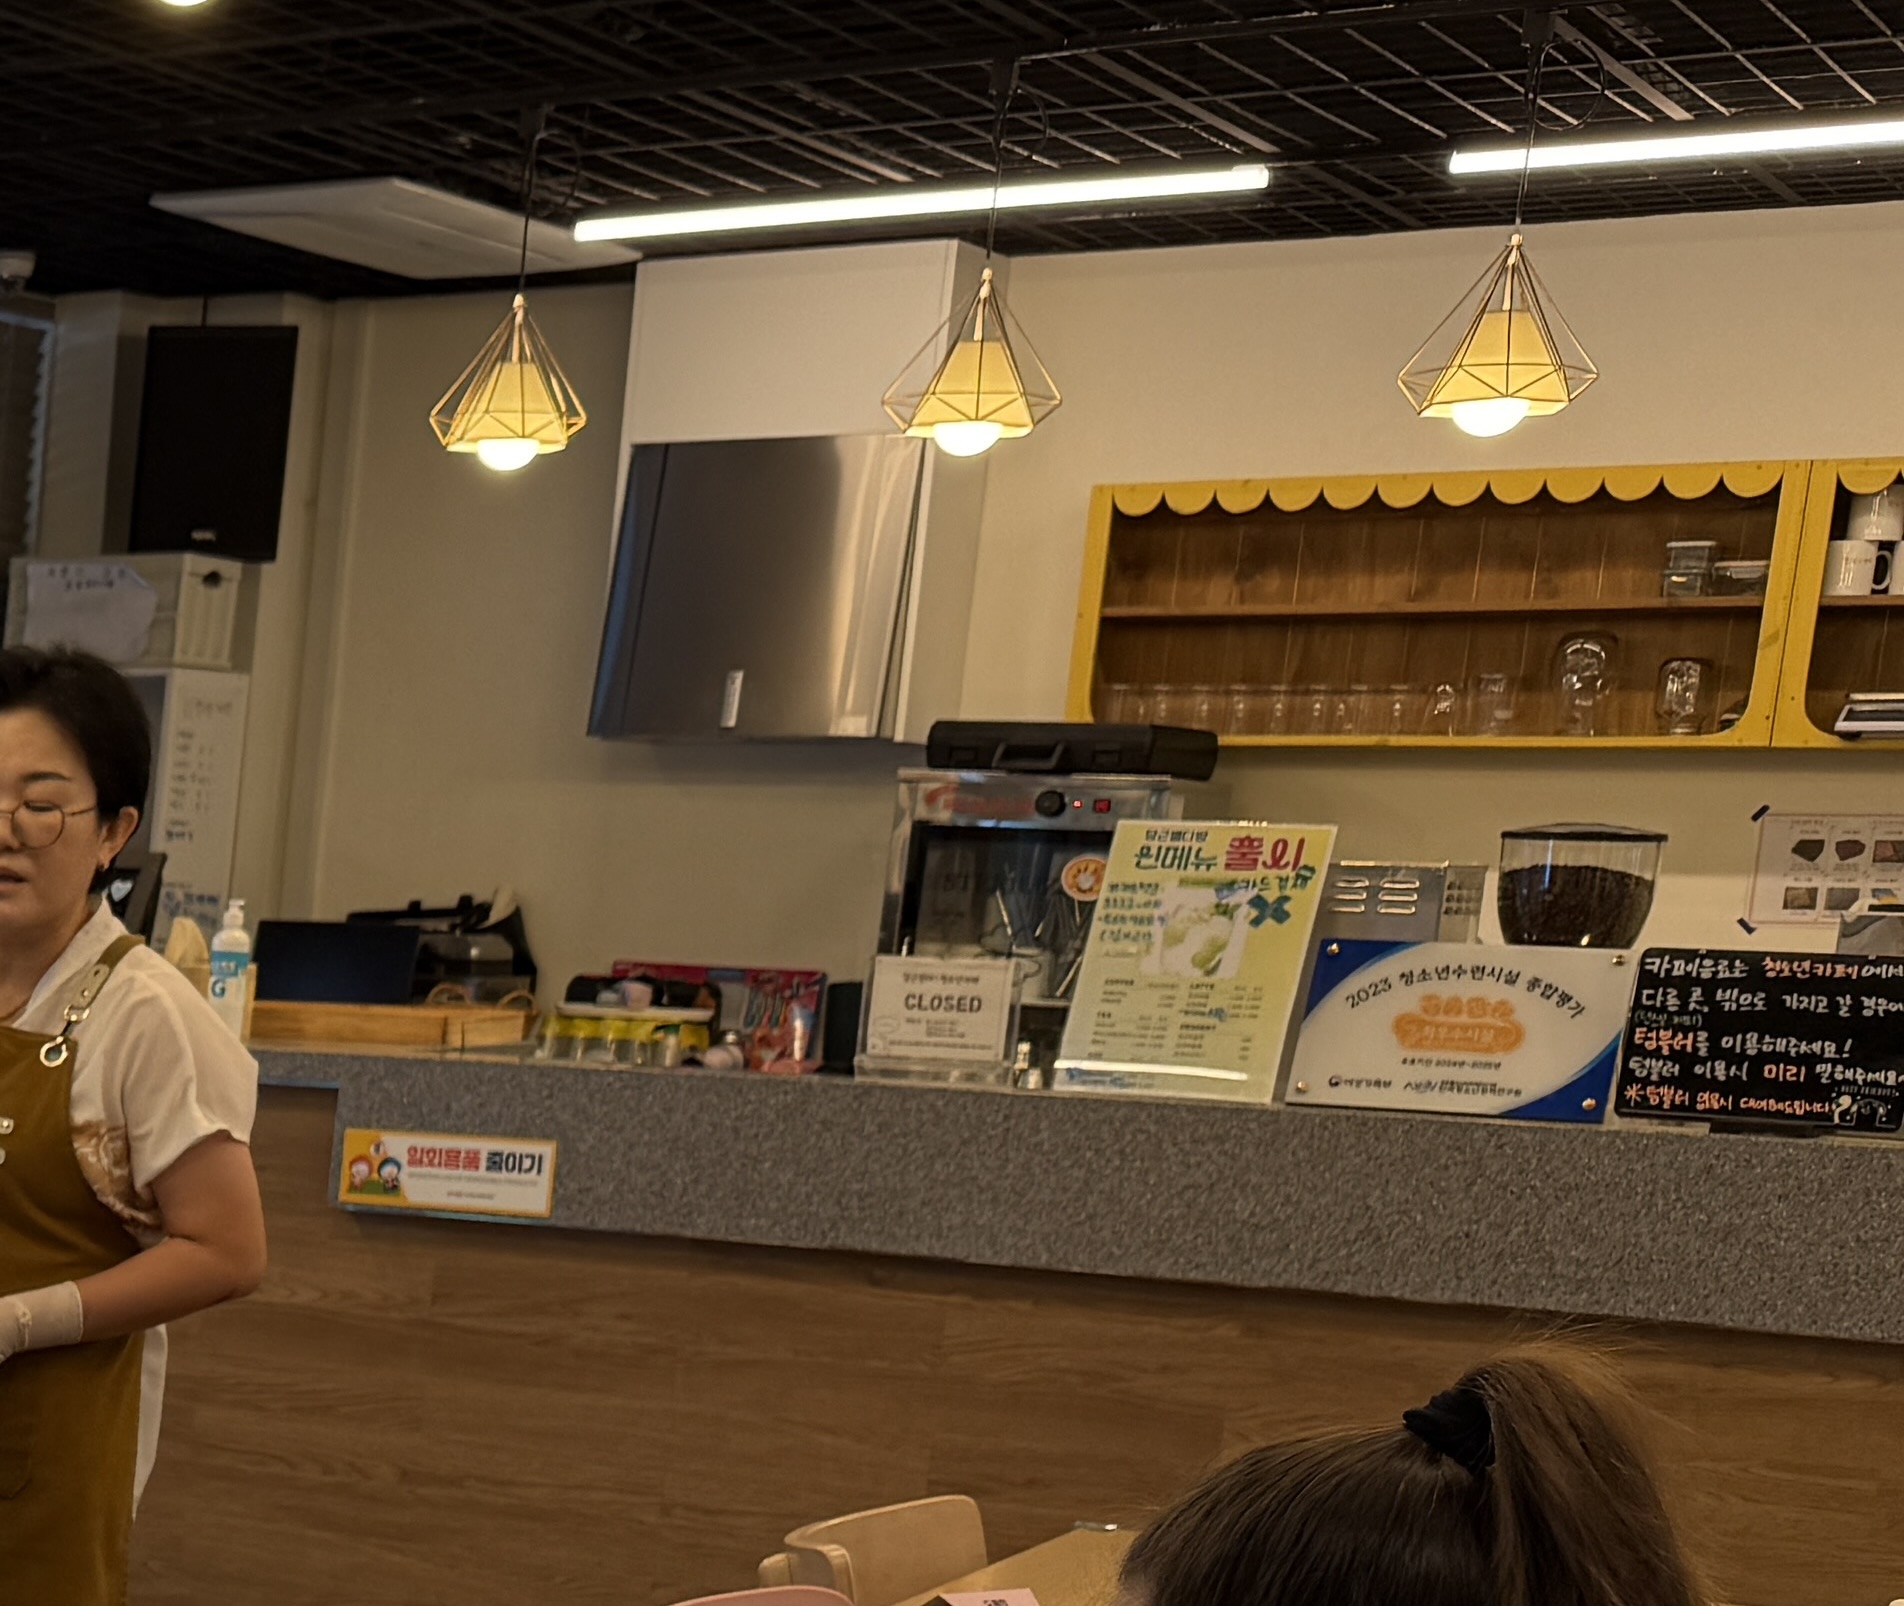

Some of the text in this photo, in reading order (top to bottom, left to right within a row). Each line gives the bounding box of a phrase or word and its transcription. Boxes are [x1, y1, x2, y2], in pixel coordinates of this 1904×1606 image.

[1644, 956, 1750, 979] 카페음료는
[904, 993, 983, 1013] CLOSED
[1345, 978, 1393, 1009] 2023
[1399, 964, 1522, 987] 청소년수련시설
[1526, 976, 1587, 1020] 종합평가
[1641, 986, 1681, 1013] 다른
[1782, 992, 1830, 1013] 가지고
[1835, 994, 1853, 1017] 갈
[1633, 1026, 1711, 1057] 텀블러를
[1628, 1055, 1680, 1081] 텀블러
[1693, 1056, 1749, 1082] 이용시
[1763, 1062, 1806, 1083] 미리
[406, 1145, 544, 1175] 일회용품 줄이기
